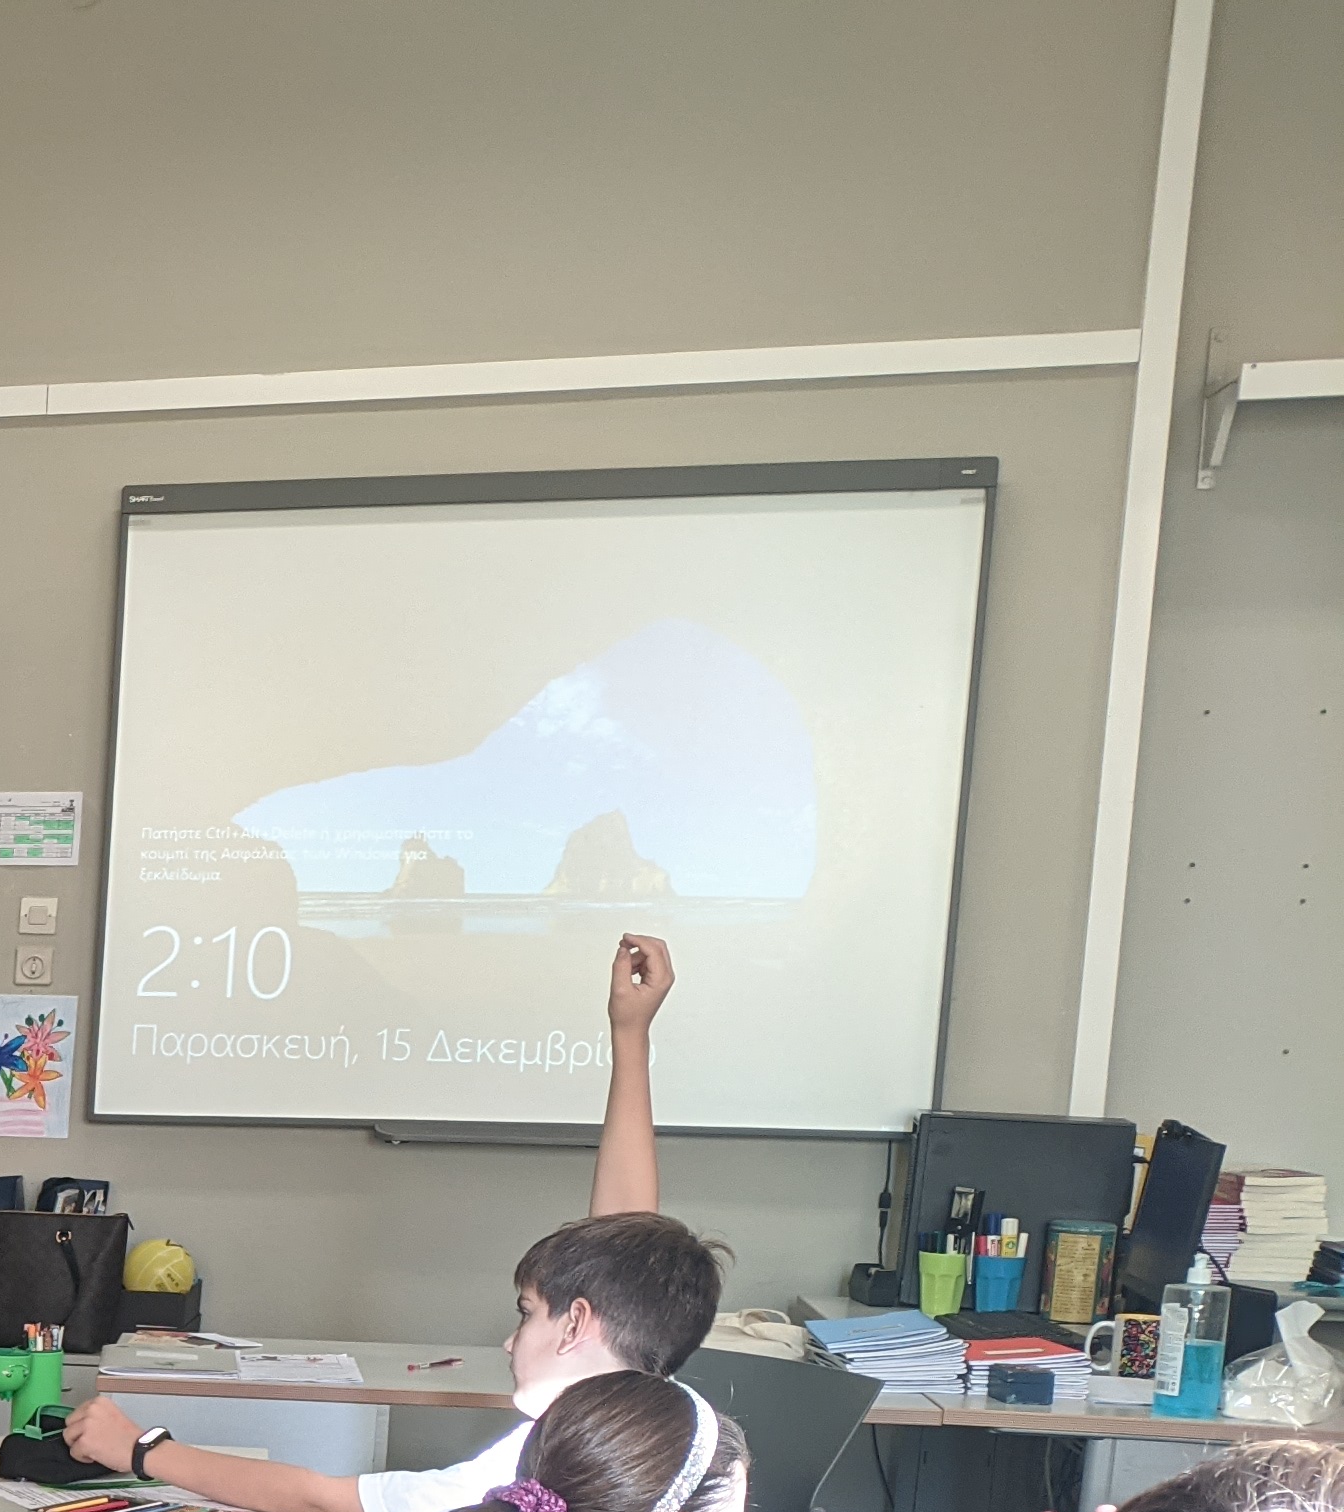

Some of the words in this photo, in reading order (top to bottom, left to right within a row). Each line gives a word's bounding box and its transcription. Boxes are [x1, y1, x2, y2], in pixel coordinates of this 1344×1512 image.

[141, 827, 202, 842] Πατήστε
[140, 847, 189, 862] κουμπί
[194, 850, 217, 862] της
[136, 925, 293, 1000] 2:10
[131, 1024, 359, 1068] Παρασκευή,
[376, 1028, 412, 1062] 15
[427, 1027, 656, 1074] Δεκεμβρί
